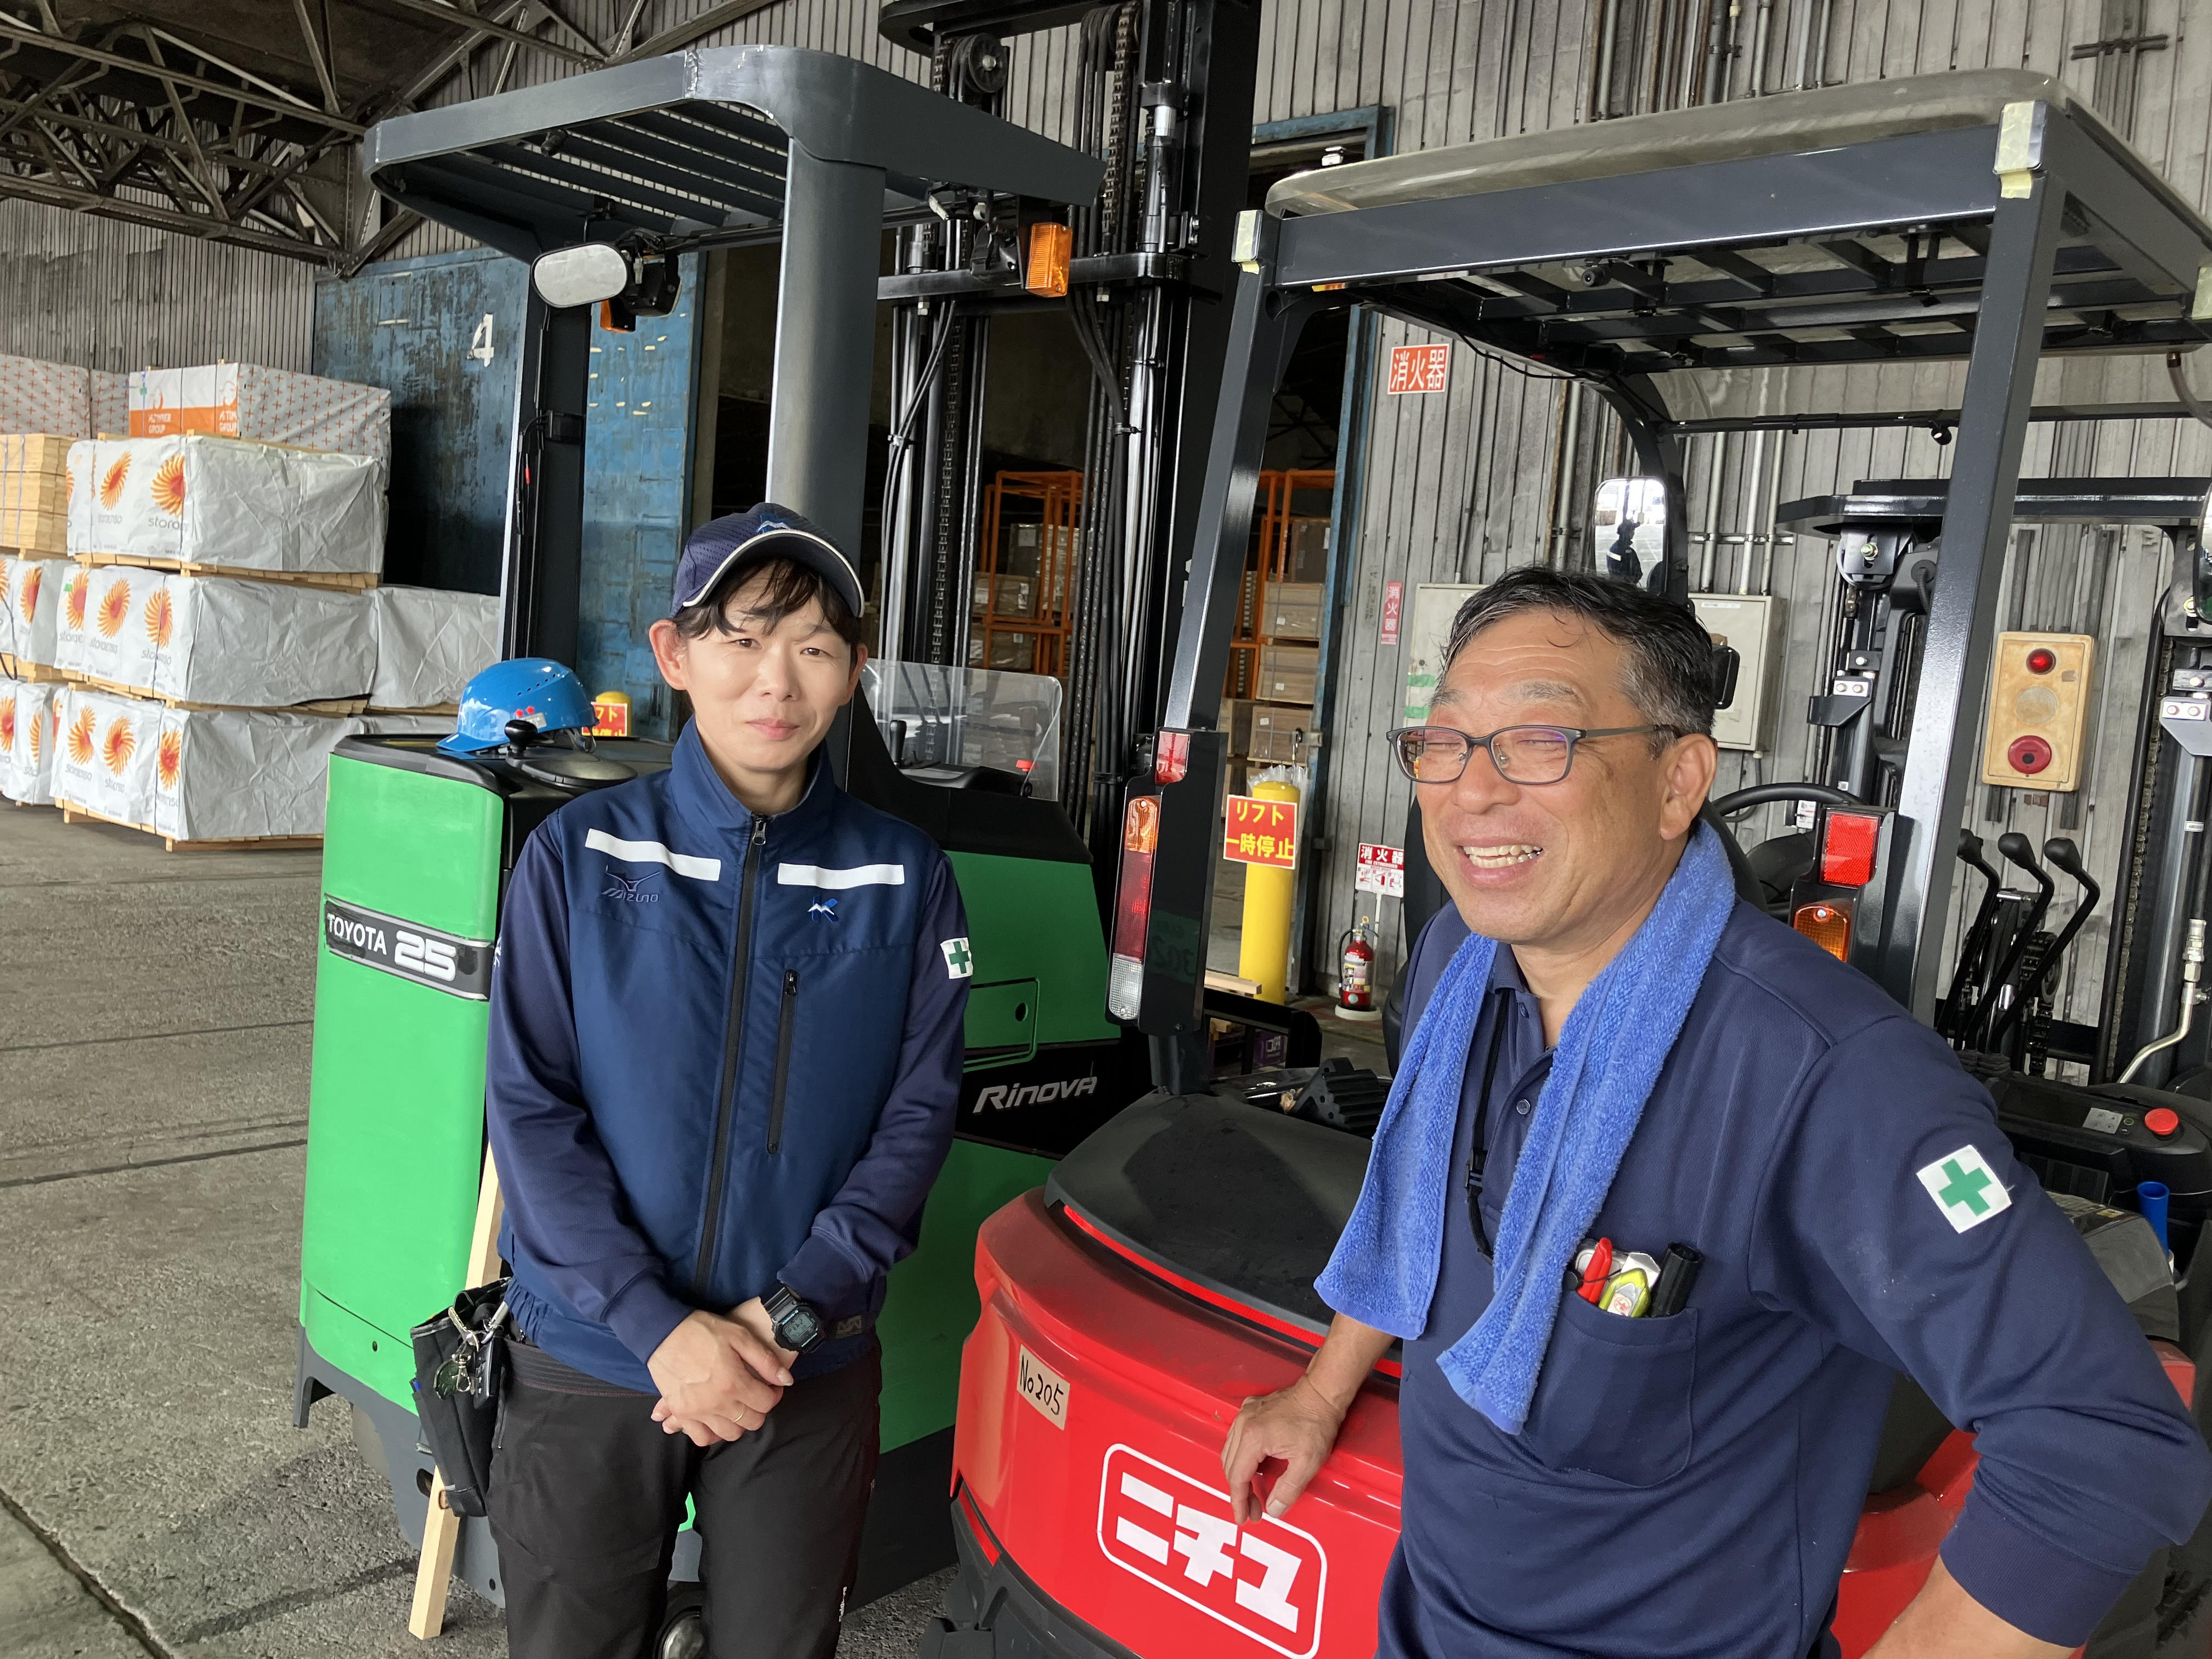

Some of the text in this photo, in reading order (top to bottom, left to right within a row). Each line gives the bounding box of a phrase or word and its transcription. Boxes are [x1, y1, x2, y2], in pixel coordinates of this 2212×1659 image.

[466, 313, 494, 368] 4
[1391, 350, 1446, 391] 消火器
[1385, 586, 1400, 631] 消火器
[596, 707, 617, 723] フト
[1237, 801, 1284, 826] リフト
[1226, 833, 1294, 860] 一時停止
[1361, 845, 1404, 865] 消火器
[328, 913, 456, 981] TOYOTA 25
